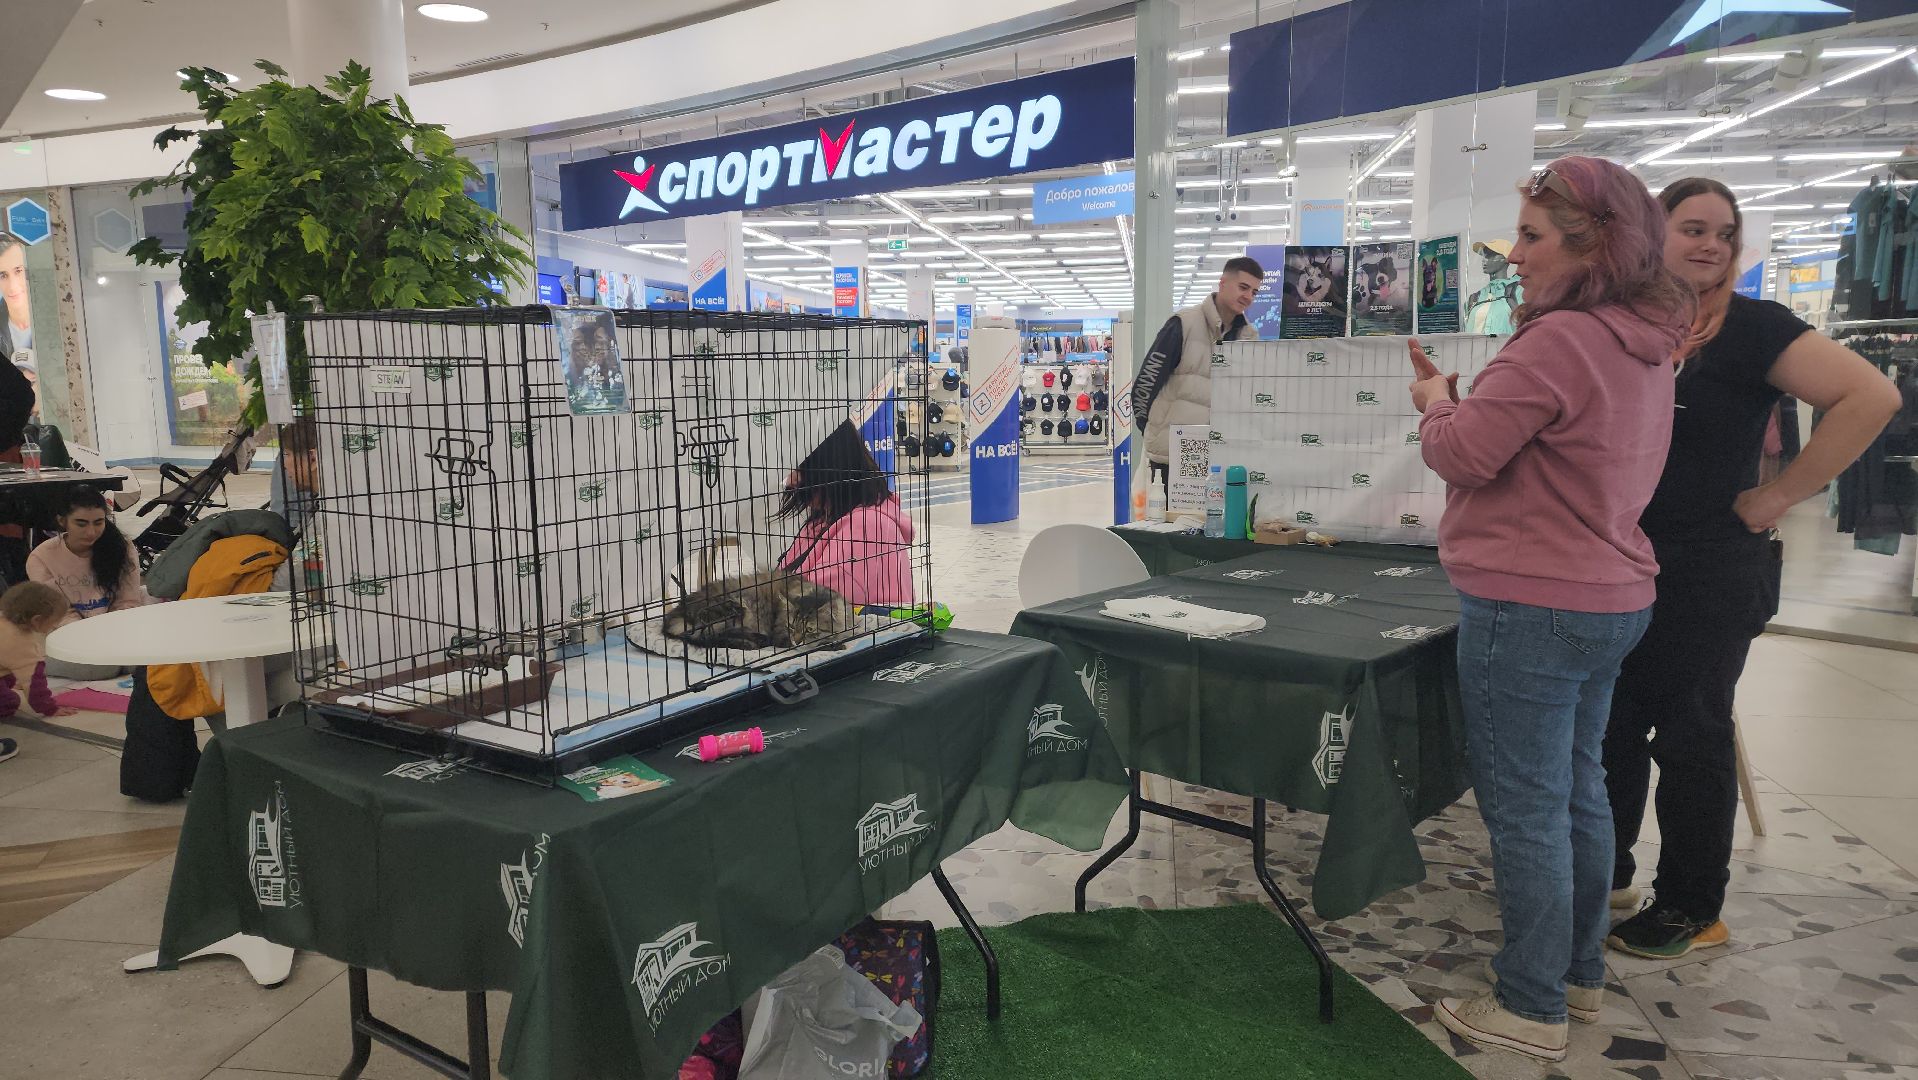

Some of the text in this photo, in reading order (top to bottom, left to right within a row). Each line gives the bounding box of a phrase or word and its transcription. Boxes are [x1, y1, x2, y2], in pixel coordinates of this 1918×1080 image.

[1045, 188, 1081, 204] Добро
[1082, 200, 1116, 211] Welcome
[695, 297, 706, 305] НА
[975, 445, 996, 459] НА
[1120, 451, 1131, 466] Н
[1056, 739, 1089, 753] ДОМ
[532, 832, 551, 878] ОМ
[282, 824, 304, 910] УЮТНЫЙ
[648, 951, 731, 1038] УЮТНЫЙ ДОМ
